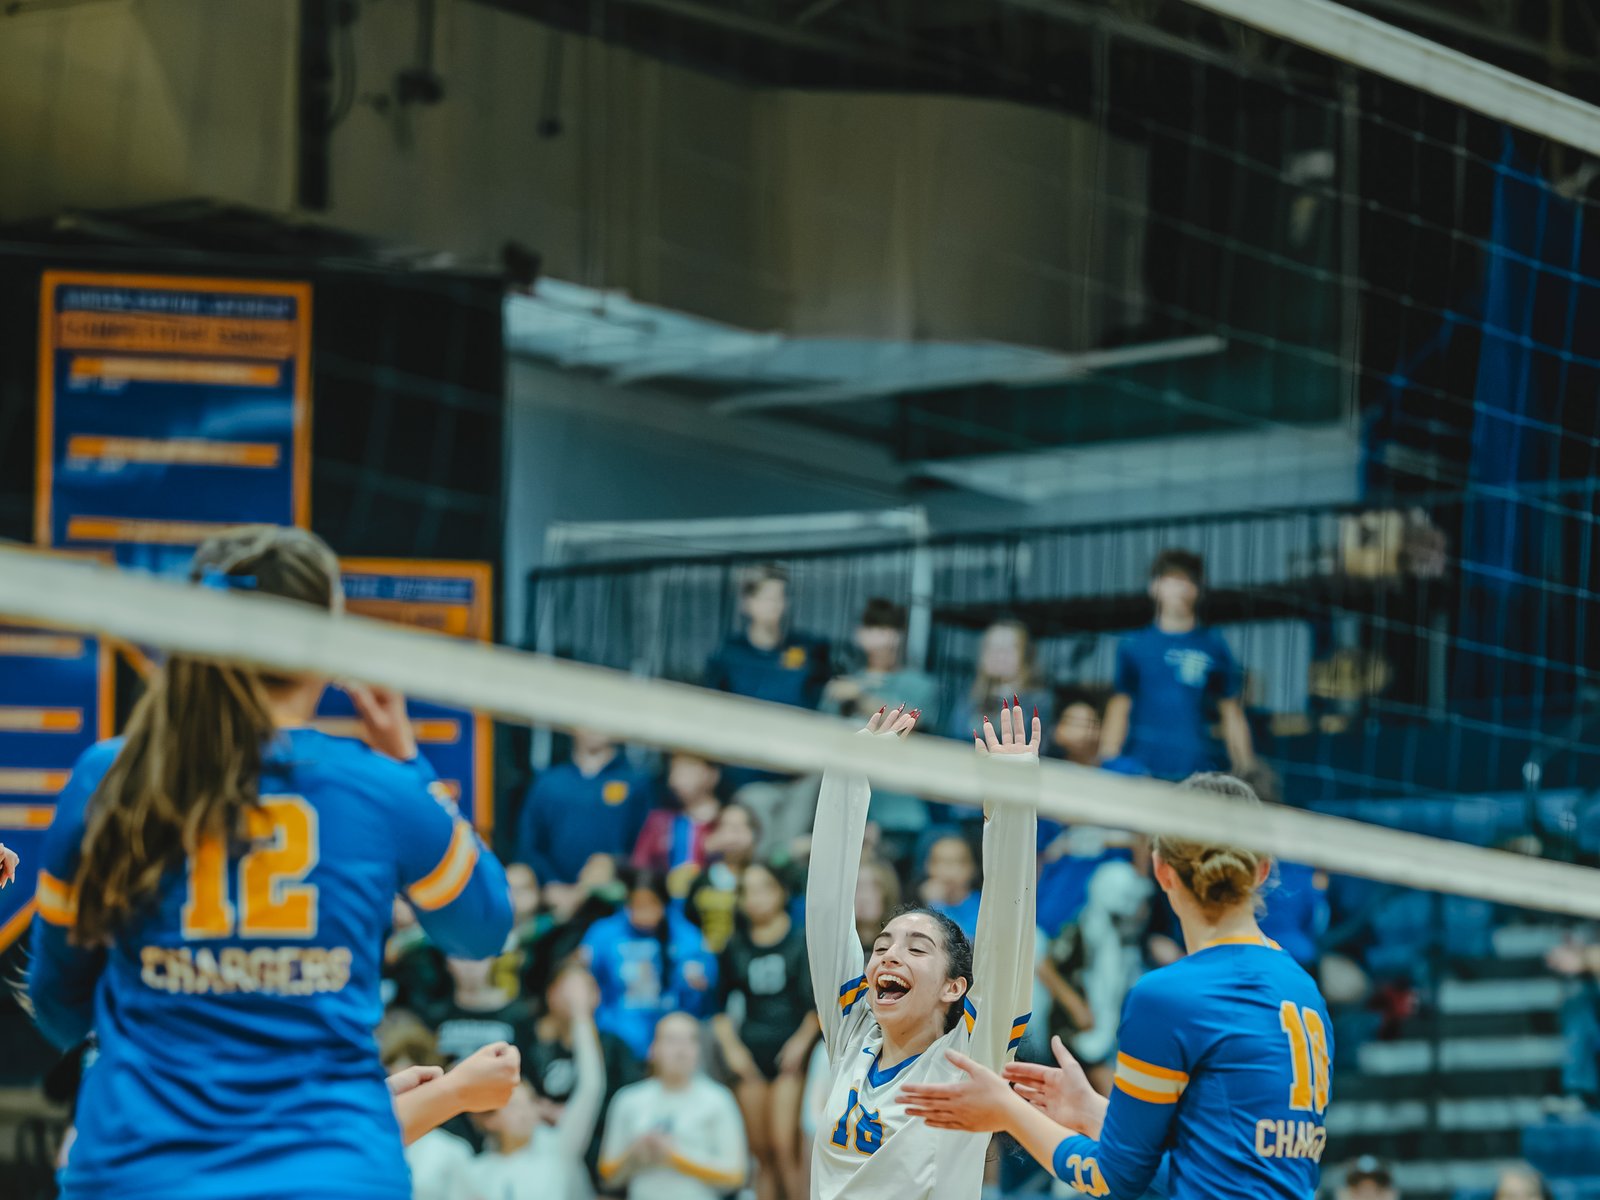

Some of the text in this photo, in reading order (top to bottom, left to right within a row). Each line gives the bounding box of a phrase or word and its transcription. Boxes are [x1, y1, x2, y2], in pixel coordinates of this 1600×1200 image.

[181, 794, 319, 940] 12
[140, 946, 352, 996] CHARGERS
[829, 1086, 884, 1157] 16
